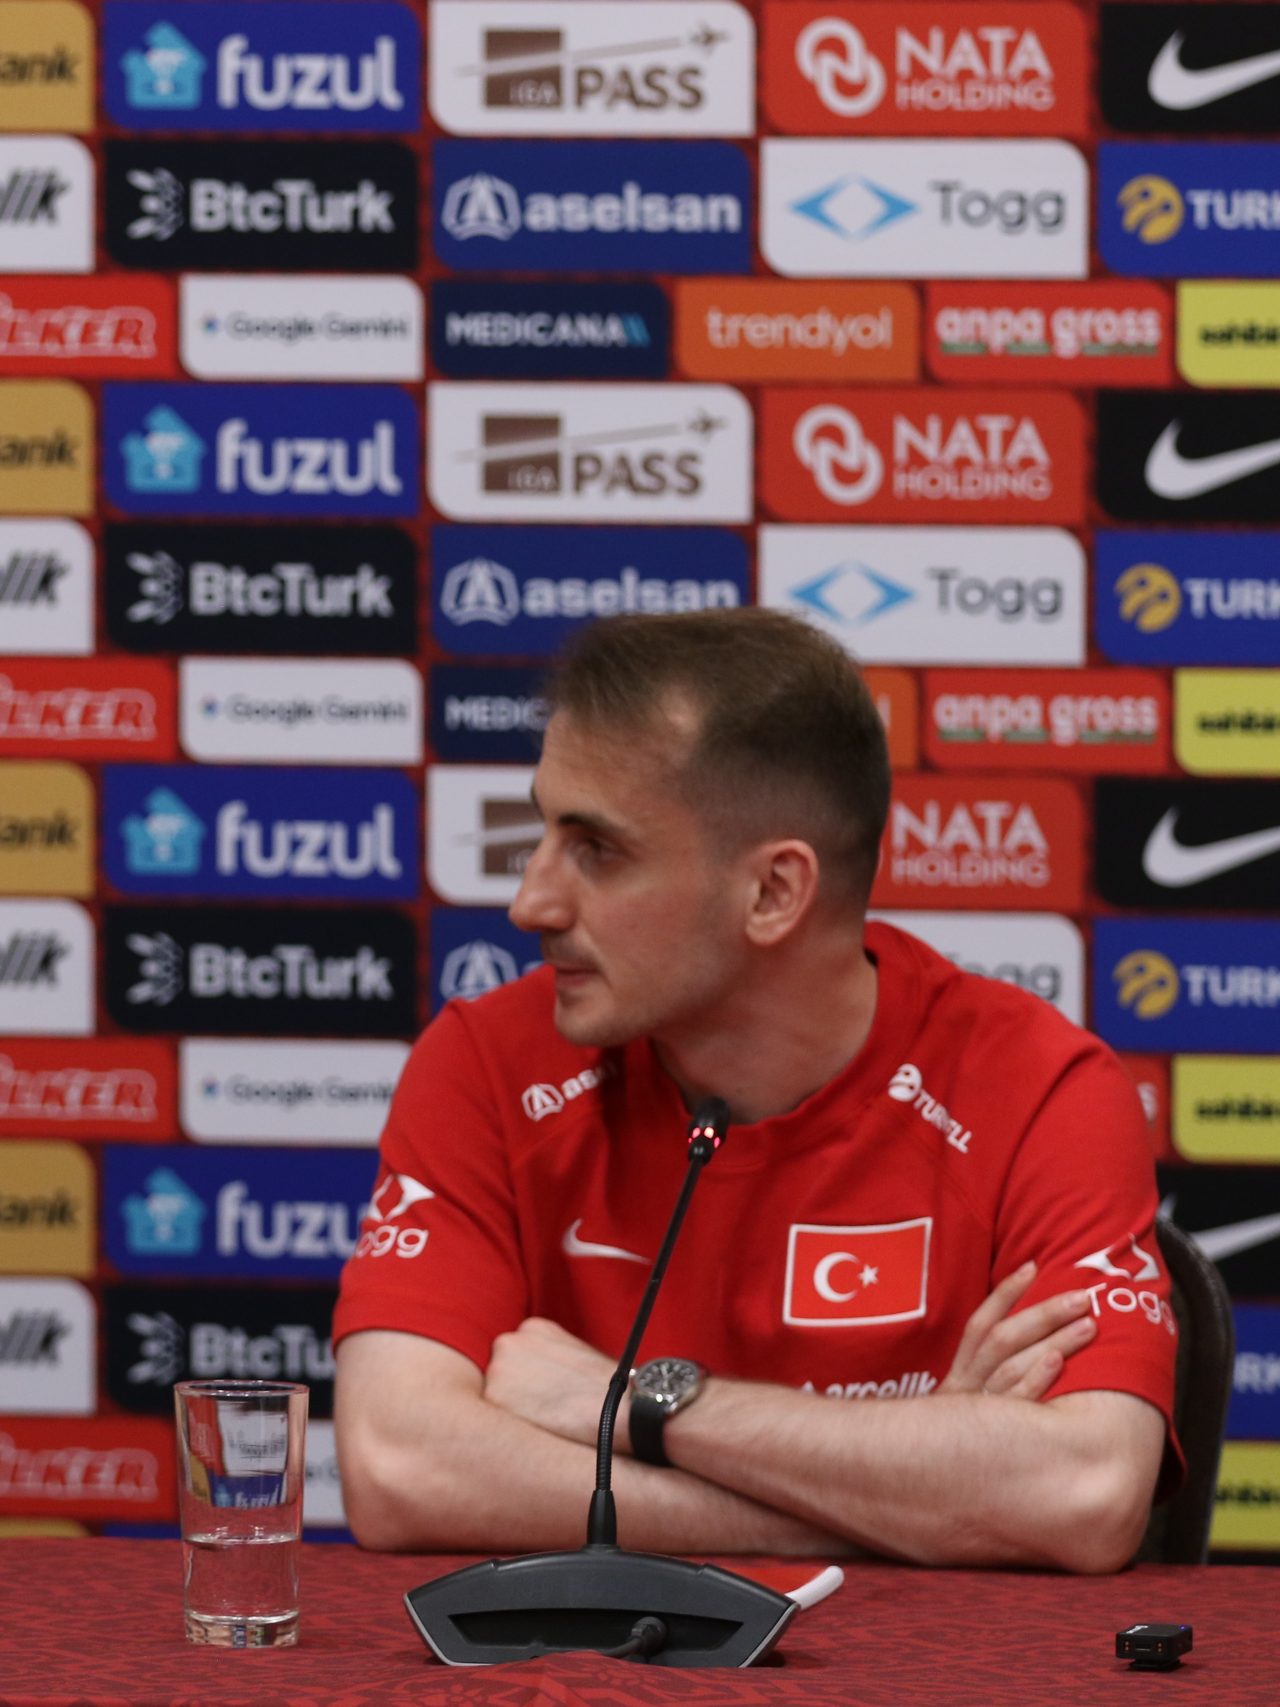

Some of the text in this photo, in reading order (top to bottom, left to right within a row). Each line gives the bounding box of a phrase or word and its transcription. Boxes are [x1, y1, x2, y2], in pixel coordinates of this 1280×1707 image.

[217, 35, 404, 110] fuzul
[897, 27, 1054, 76] NATA
[574, 66, 706, 111] PASS
[897, 79, 1056, 111] HOLDING
[190, 178, 395, 233] BtcTurk
[524, 183, 741, 234] aselsan
[927, 180, 1067, 236] Togg
[446, 312, 625, 347] MEDICANA
[707, 306, 892, 355] trendyol
[935, 306, 1045, 352] anpa
[1051, 306, 1161, 359] gross
[217, 418, 402, 495] fuzul
[894, 414, 1050, 464] NATA
[572, 451, 704, 498] PASS
[894, 467, 1052, 500] HOLDING
[190, 562, 394, 618] BtcTurk
[523, 566, 740, 618] aselsan
[926, 567, 1064, 623] Togg
[445, 694, 549, 732] MEDIC
[1049, 693, 1158, 746] gross
[217, 800, 401, 879] fuzul
[890, 800, 1049, 853] NATA
[890, 855, 1051, 888] HOLDING
[189, 942, 394, 1001] BtcTurk
[216, 1180, 366, 1259] fuzu
[354, 1224, 430, 1259] ogg
[189, 1323, 337, 1379] BtcTu
